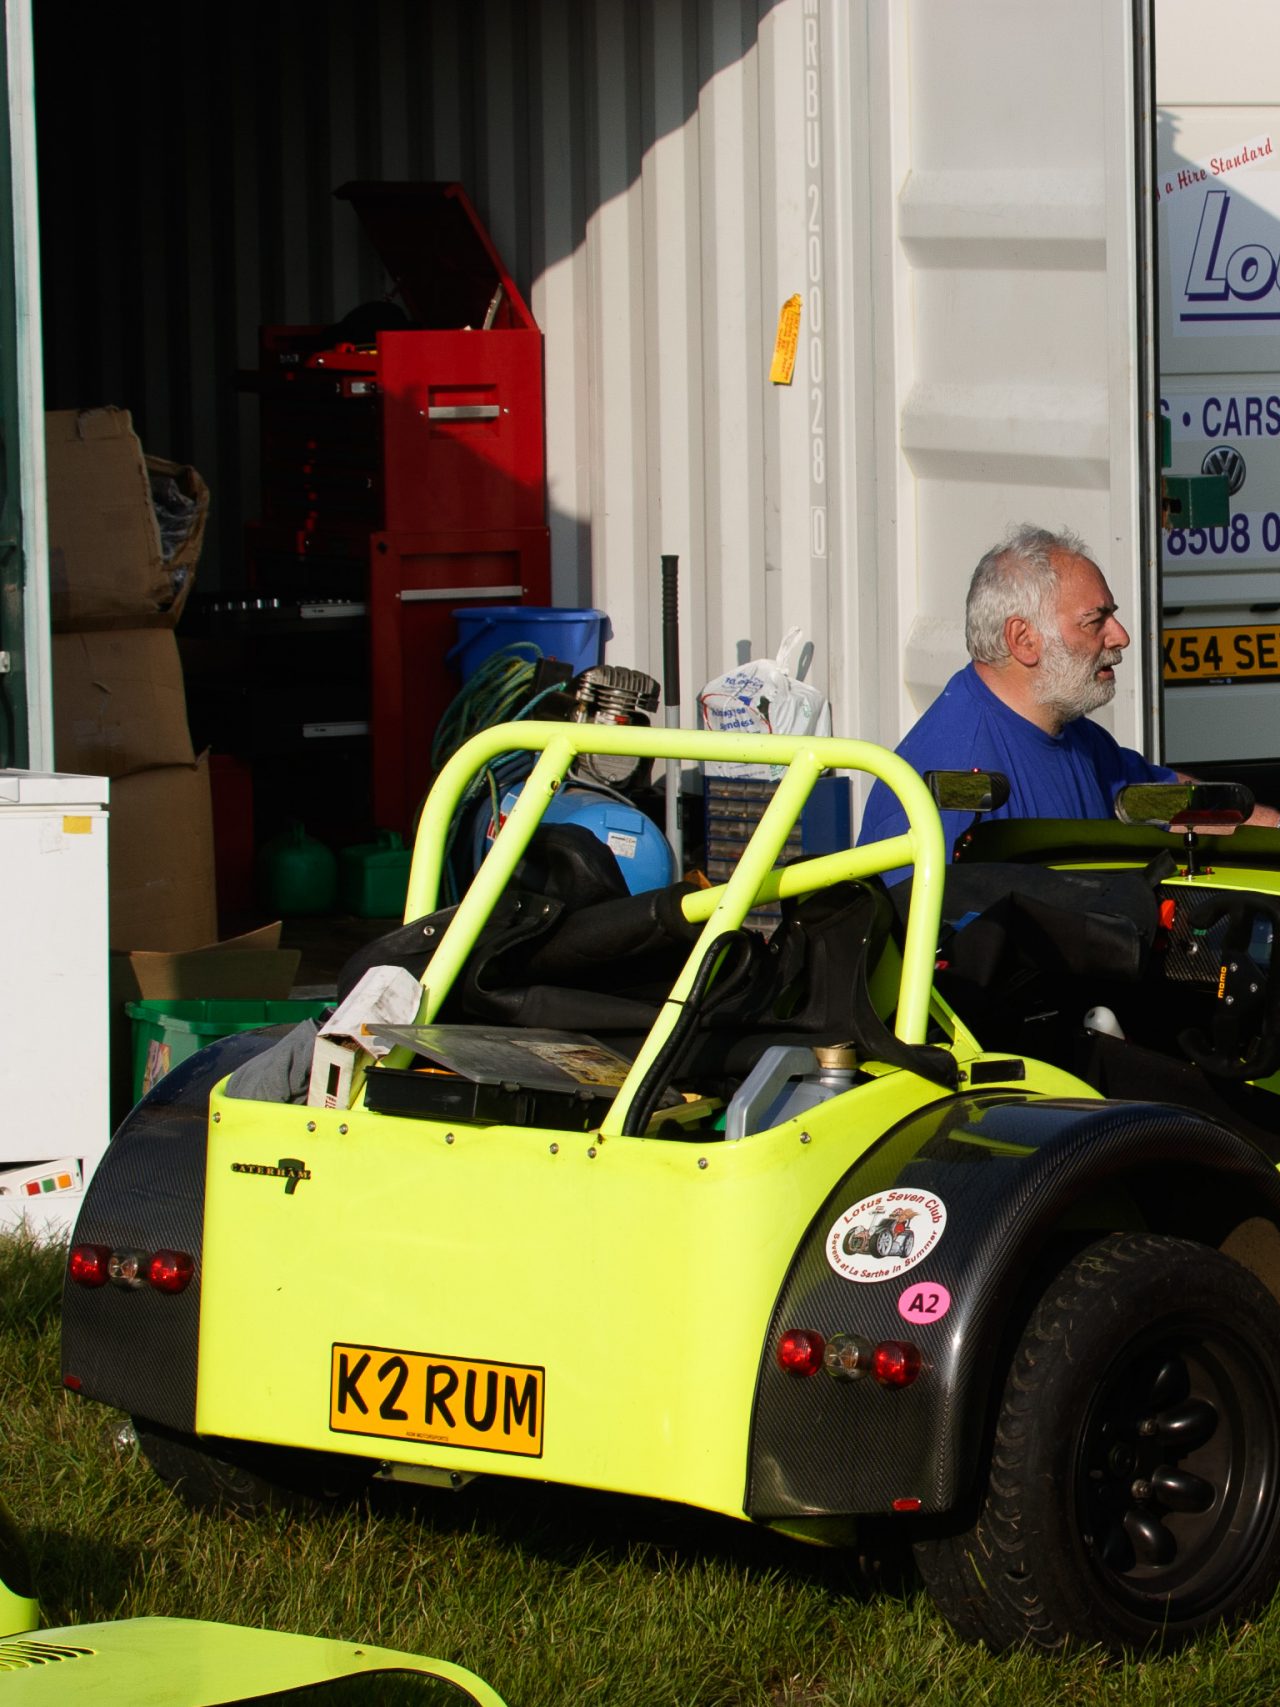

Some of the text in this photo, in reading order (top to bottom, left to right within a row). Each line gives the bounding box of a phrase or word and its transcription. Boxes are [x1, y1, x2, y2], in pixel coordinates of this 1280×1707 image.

[1165, 182, 1174, 194] a
[1177, 168, 1208, 190] Hire
[1210, 136, 1273, 176] Standard
[1167, 513, 1251, 556] 8508
[1218, 966, 1227, 998] momo
[231, 1164, 307, 1179] CATERHAM
[844, 1191, 943, 1224] Lotus Seven Club
[831, 1230, 938, 1278] Sevens at La Sarthe in Summer
[908, 1293, 940, 1314] A2
[338, 1353, 538, 1438] K2 RUM
